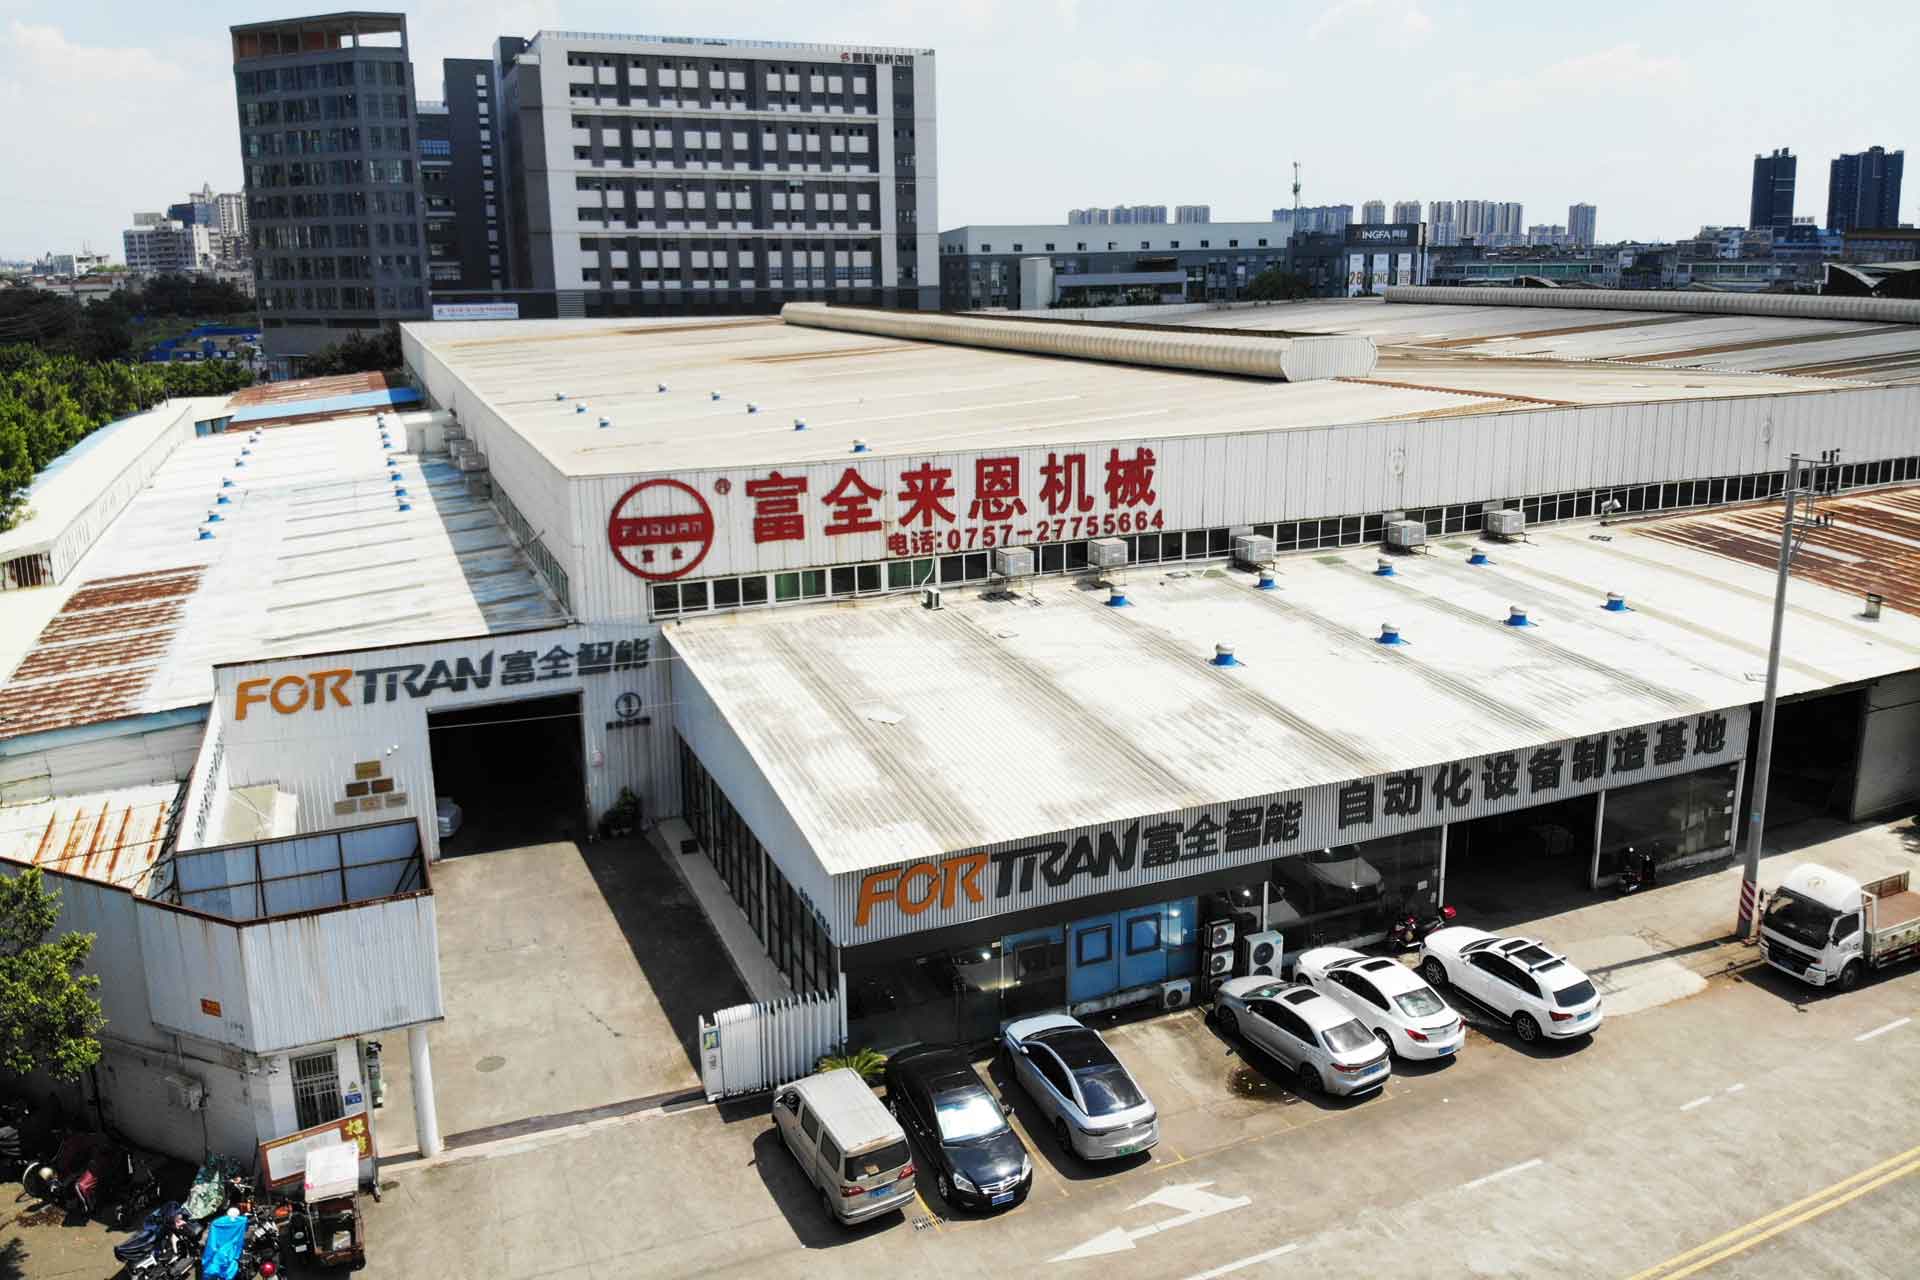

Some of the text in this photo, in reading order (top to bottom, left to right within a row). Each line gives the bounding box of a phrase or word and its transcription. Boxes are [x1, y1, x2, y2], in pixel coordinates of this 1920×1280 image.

[745, 446, 1157, 545] 富全来恩机械
[235, 637, 650, 721] FORTRAN 富全智能
[855, 821, 1140, 927] FORTRAN
[1142, 800, 1303, 869] 富全智能
[1338, 714, 1727, 829] 自动化设备制造基地
